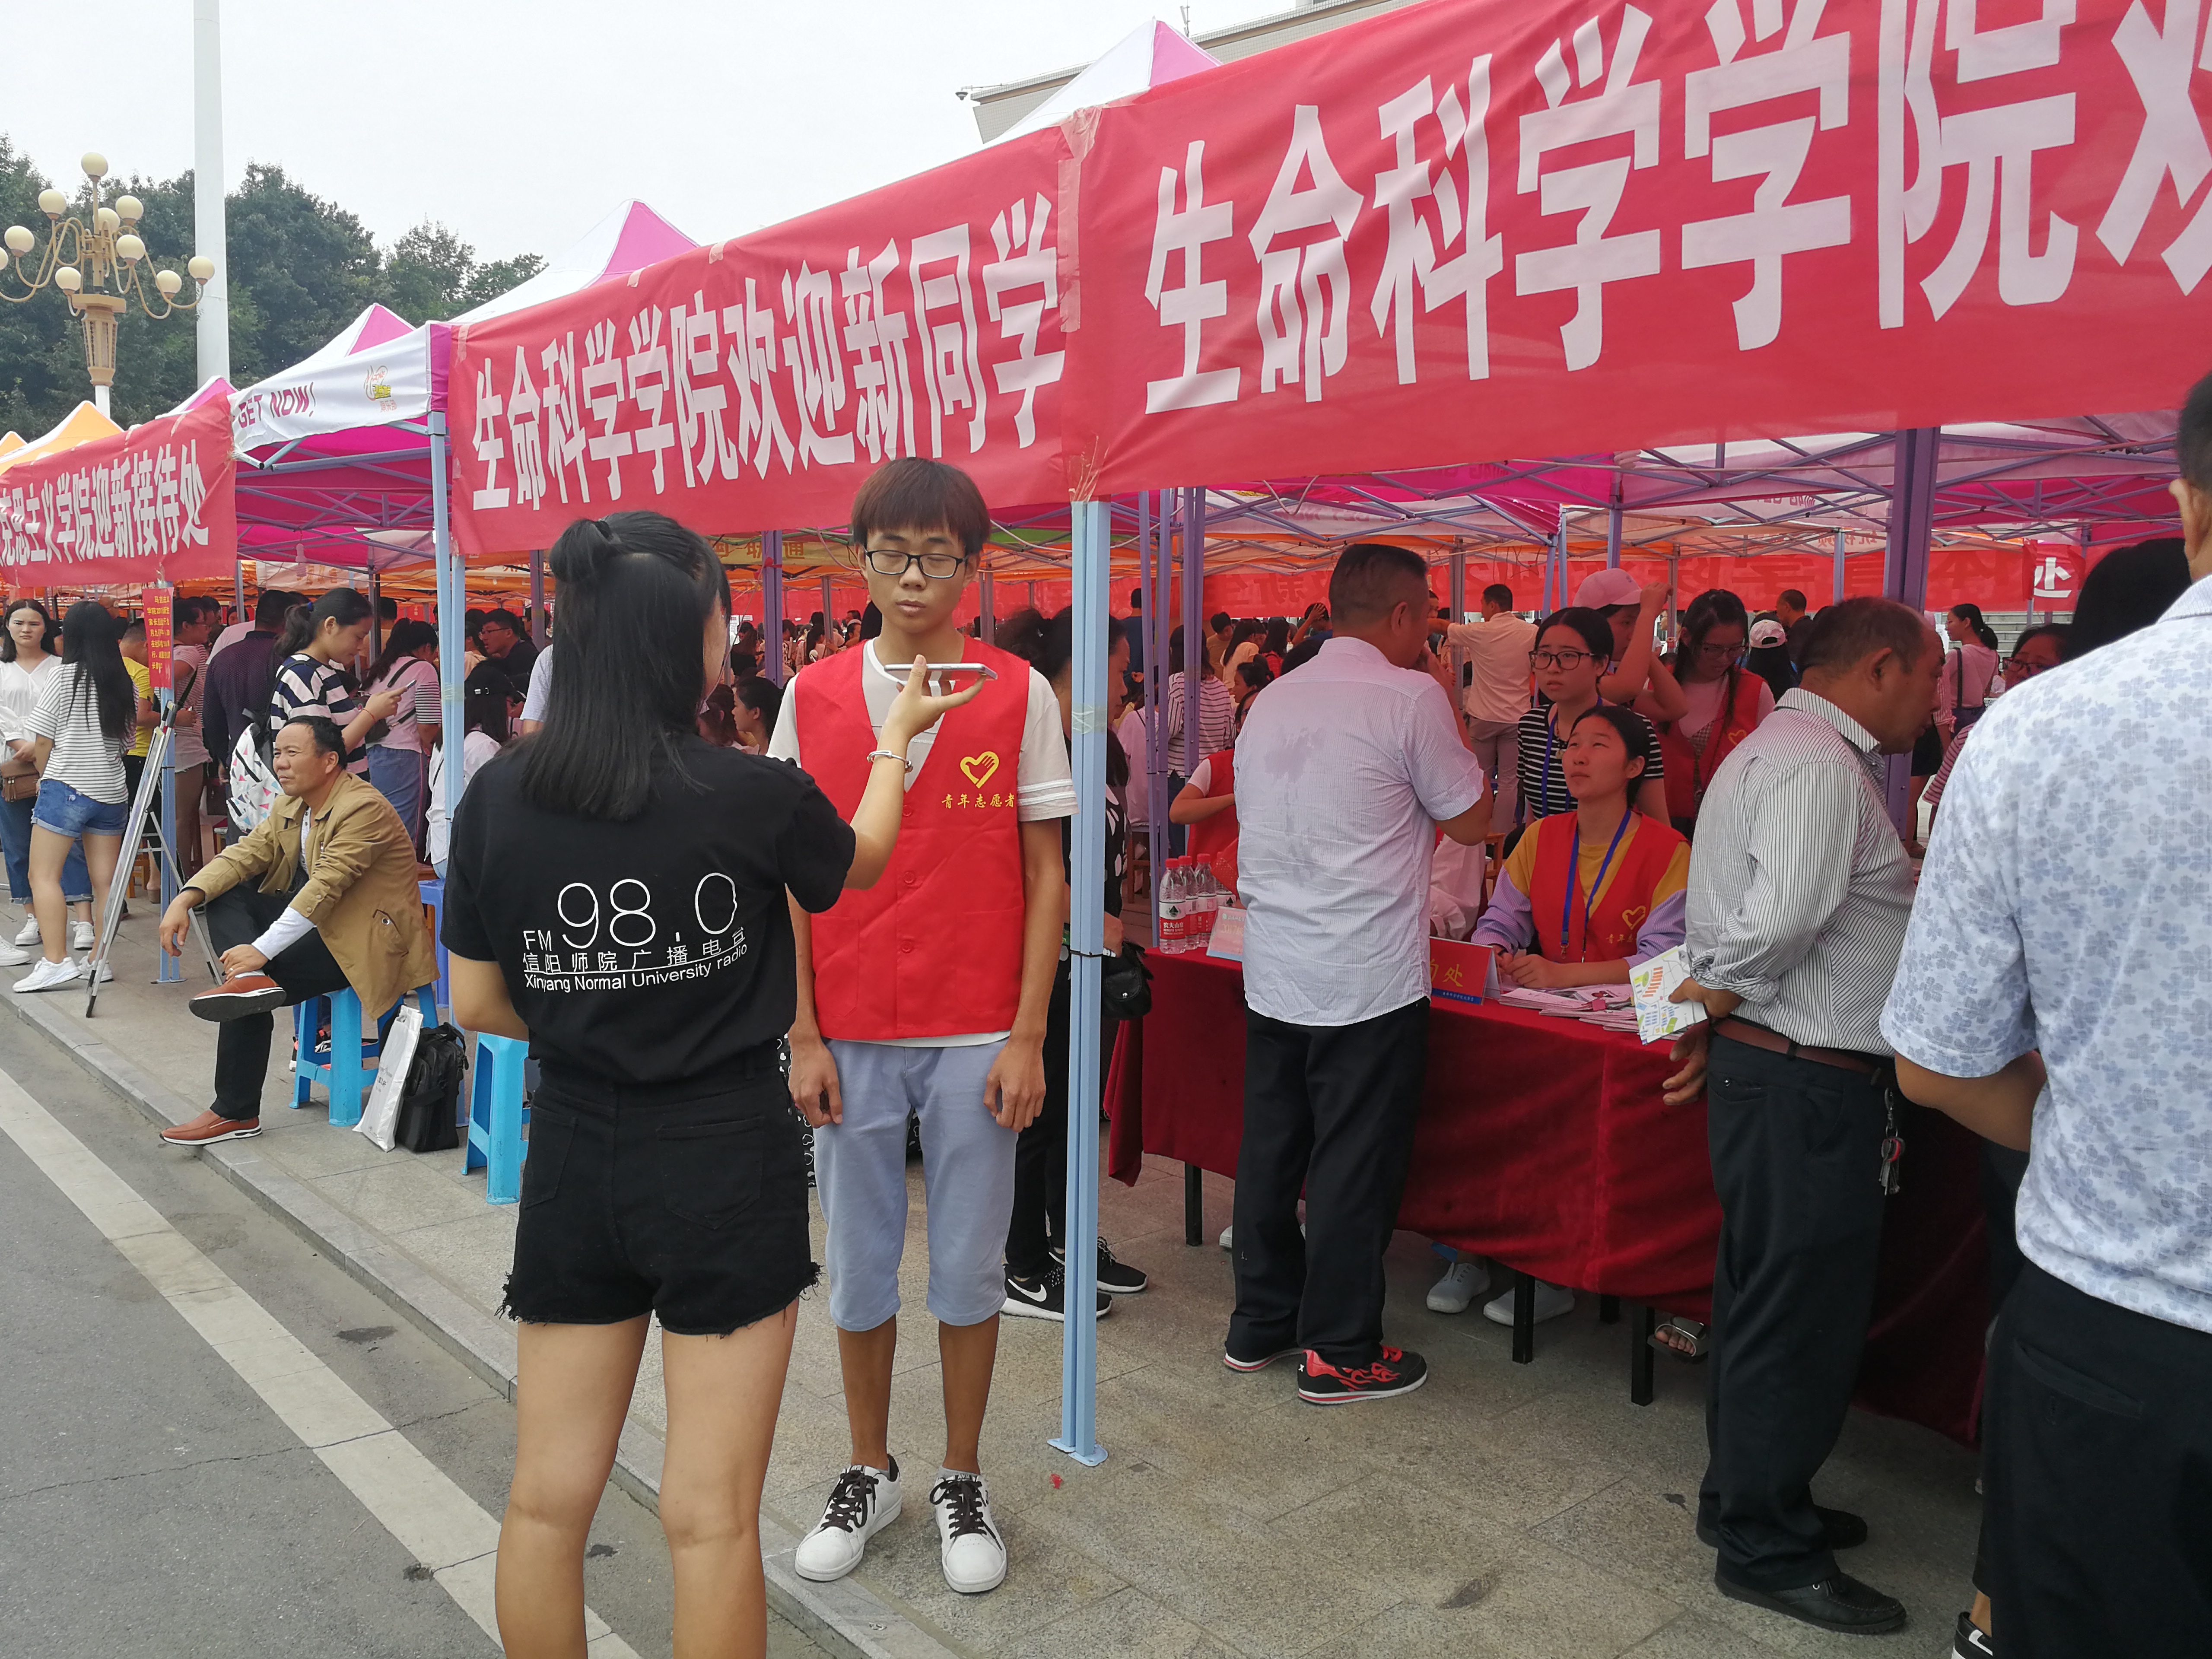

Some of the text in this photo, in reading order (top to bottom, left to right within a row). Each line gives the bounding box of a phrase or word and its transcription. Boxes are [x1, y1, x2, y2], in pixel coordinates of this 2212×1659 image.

[474, 193, 1065, 510] 生命科学学院欢迎新同学
[238, 382, 316, 428] GET NOW!
[941, 793, 1015, 809] 青年志愿者
[523, 872, 737, 951] FM 98.0
[575, 975, 626, 991] Normal
[632, 961, 712, 987] University
[717, 944, 747, 970] radio
